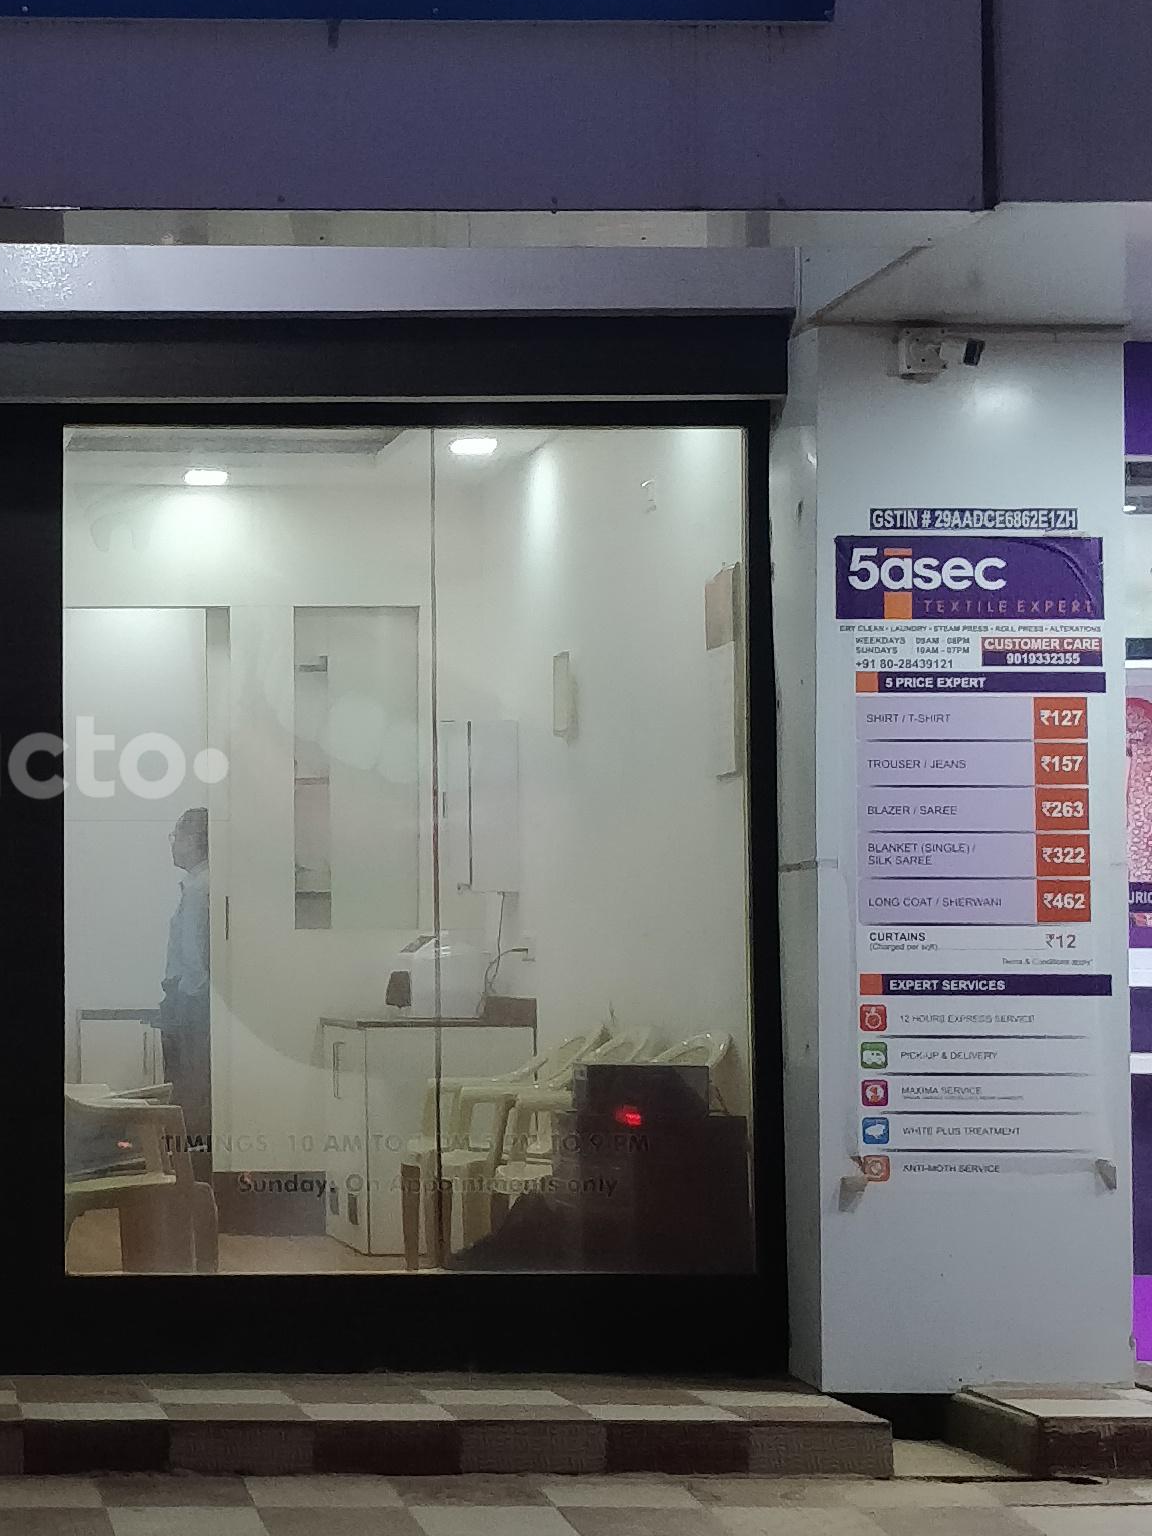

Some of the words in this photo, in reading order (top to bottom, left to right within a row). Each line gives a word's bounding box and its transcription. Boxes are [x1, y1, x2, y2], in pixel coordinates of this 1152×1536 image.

[871, 510, 918, 528] GSTIN
[921, 511, 931, 528] #
[923, 599, 1008, 613] TEXTILE
[1017, 599, 1093, 613] EXPERT
[984, 638, 1060, 650] CUSTOMER
[1063, 638, 1100, 650] CARE
[856, 659, 876, 668] +91
[880, 658, 953, 669] 80-28439121
[885, 677, 893, 688] 5
[895, 677, 934, 688] PRICE
[936, 677, 987, 688] EXPERT
[866, 713, 899, 723] SHIRT
[909, 713, 951, 723] T-SHIRT
[1040, 709, 1083, 726] ₹127
[867, 759, 921, 769] TROUSER
[930, 759, 967, 769] JEANS
[1040, 755, 1084, 772] ₹157
[867, 805, 910, 816] BLAZER
[920, 805, 958, 816] SAREE
[1041, 801, 1084, 818] ₹263
[867, 843, 918, 853] BLANKET
[921, 843, 970, 854] (SINGLE)
[1042, 847, 1086, 863] ₹322
[868, 856, 892, 865] SILK
[895, 855, 933, 865] SAREE
[868, 897, 899, 907] LONG
[903, 897, 933, 907] COAT
[942, 897, 1002, 907] SHERWANI
[1043, 893, 1086, 909] ₹462
[869, 932, 926, 942] CURTAINS
[1046, 933, 1077, 949] ₹12
[889, 979, 938, 991] EXPERT
[941, 979, 1006, 991] SERVICES
[941, 1086, 982, 1095] SERVICE
[958, 1165, 1000, 1173] SERVICE
[237, 1173, 338, 1197] Sunday:
[567, 1175, 618, 1197] only
